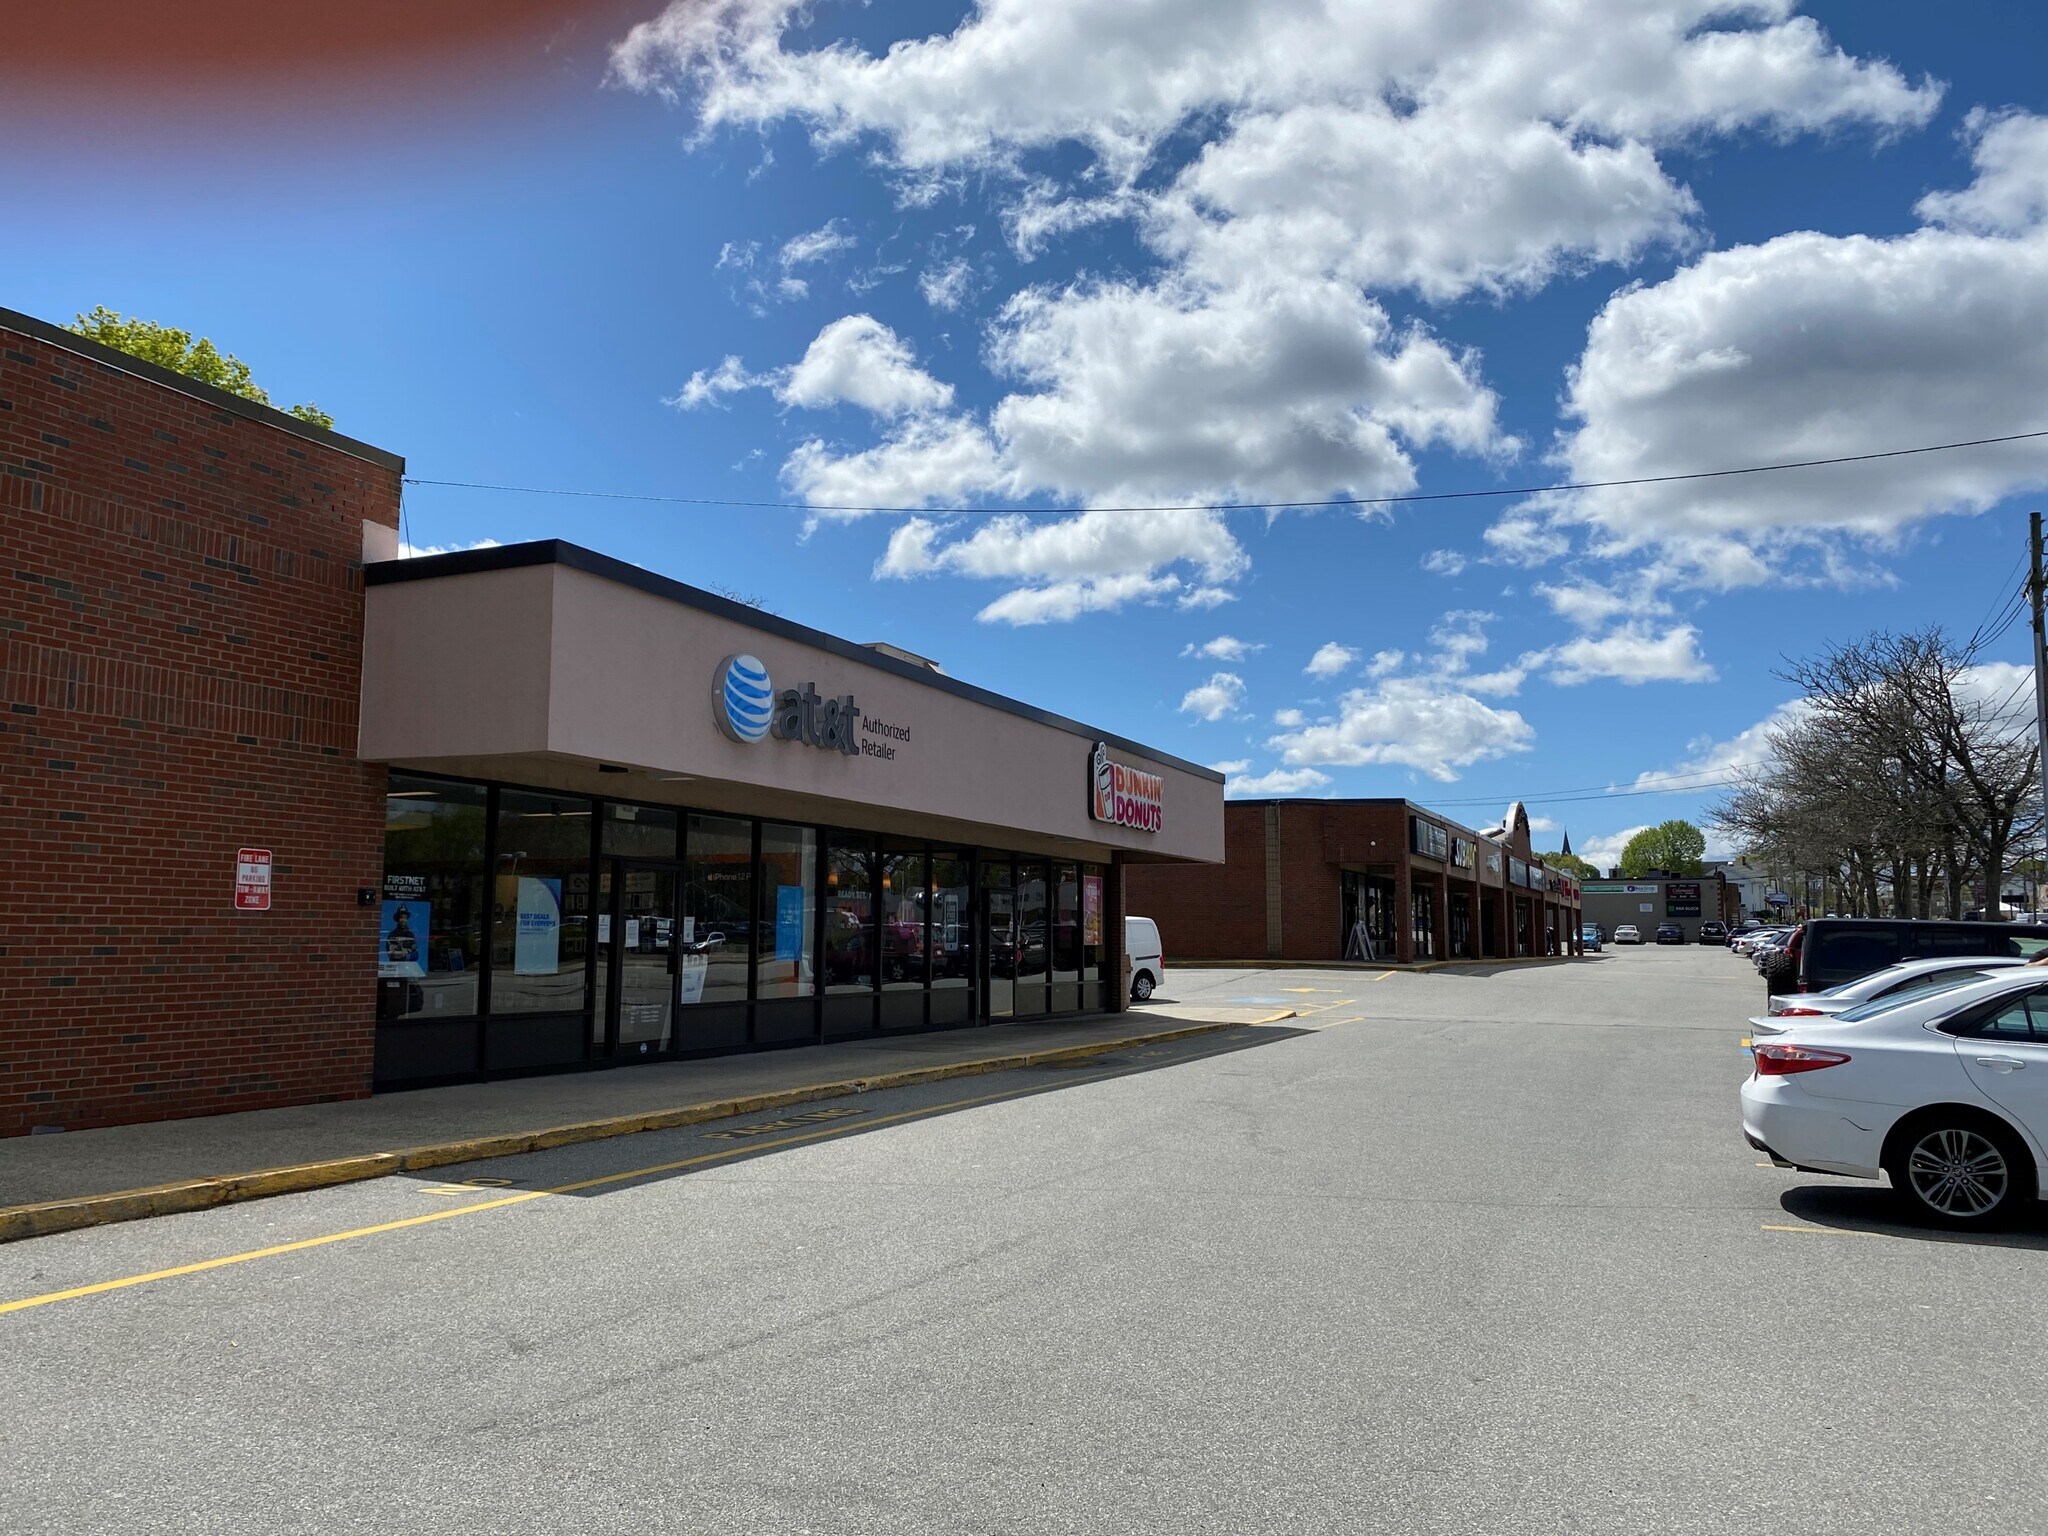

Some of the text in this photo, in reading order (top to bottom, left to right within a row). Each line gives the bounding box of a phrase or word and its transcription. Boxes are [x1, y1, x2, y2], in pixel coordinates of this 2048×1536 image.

[772, 682, 860, 756] at&t
[861, 715, 911, 742] Authorized
[861, 738, 896, 761] Retailer
[1116, 795, 1162, 831] DONUTS
[240, 854, 269, 864] FIRE LANE
[242, 875, 265, 883] PARKING
[386, 875, 425, 886] FIRSTNET
[244, 895, 260, 904] ZONE
